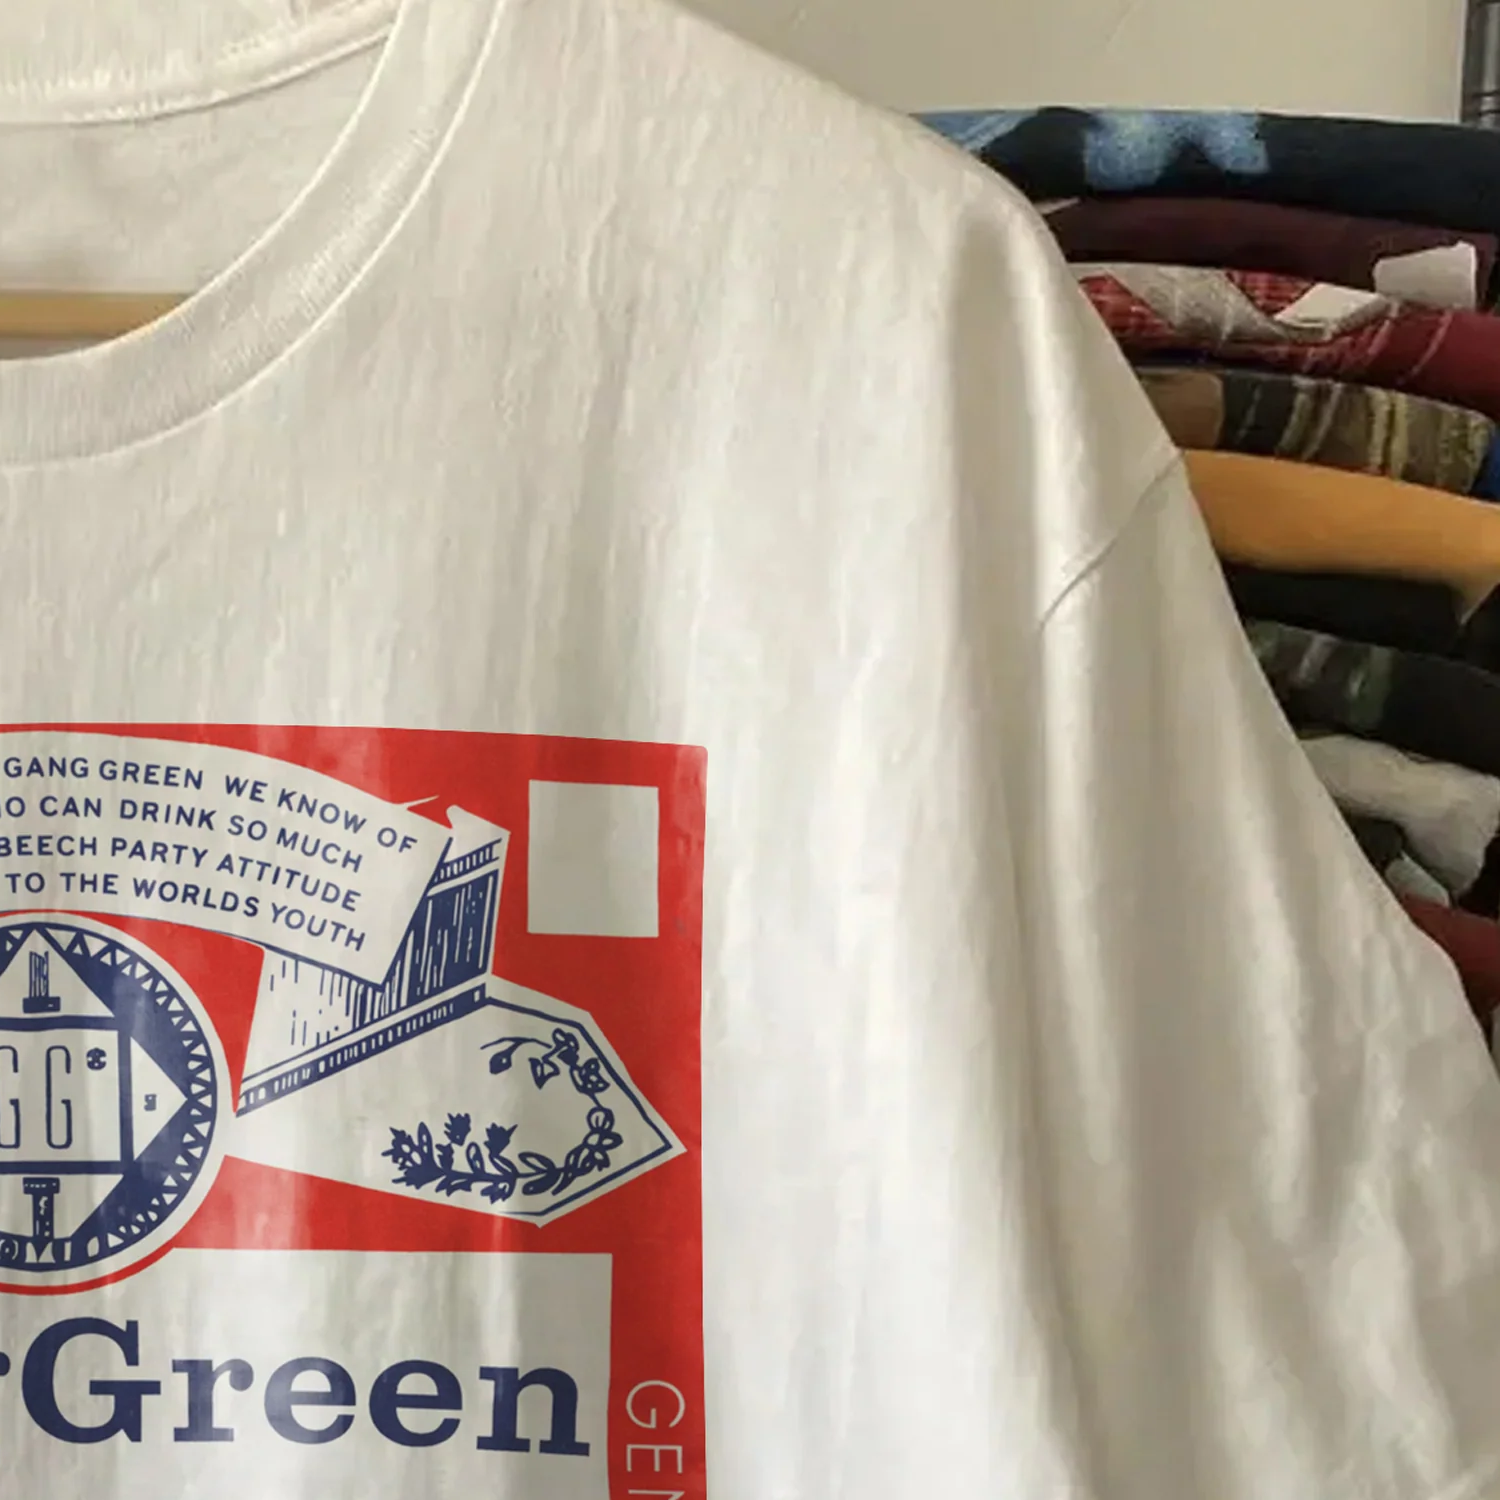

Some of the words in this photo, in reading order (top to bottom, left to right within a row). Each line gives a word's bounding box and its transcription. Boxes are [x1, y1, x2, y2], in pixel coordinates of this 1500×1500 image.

[3, 756, 89, 779] GANG
[98, 759, 203, 790] GREEN
[224, 775, 268, 803] WE
[277, 788, 367, 834] KNOW
[377, 827, 417, 855] OF
[39, 795, 102, 818] CAN
[119, 799, 217, 831] DRINK
[227, 815, 267, 841] SO
[276, 827, 362, 873] MUCH
[4, 872, 46, 894] TO
[59, 872, 119, 895] THE
[133, 878, 260, 918] WORLDS
[270, 902, 365, 952] YOUTH
[111, 837, 208, 868] PARTY
[216, 853, 361, 912] ATTITUDE
